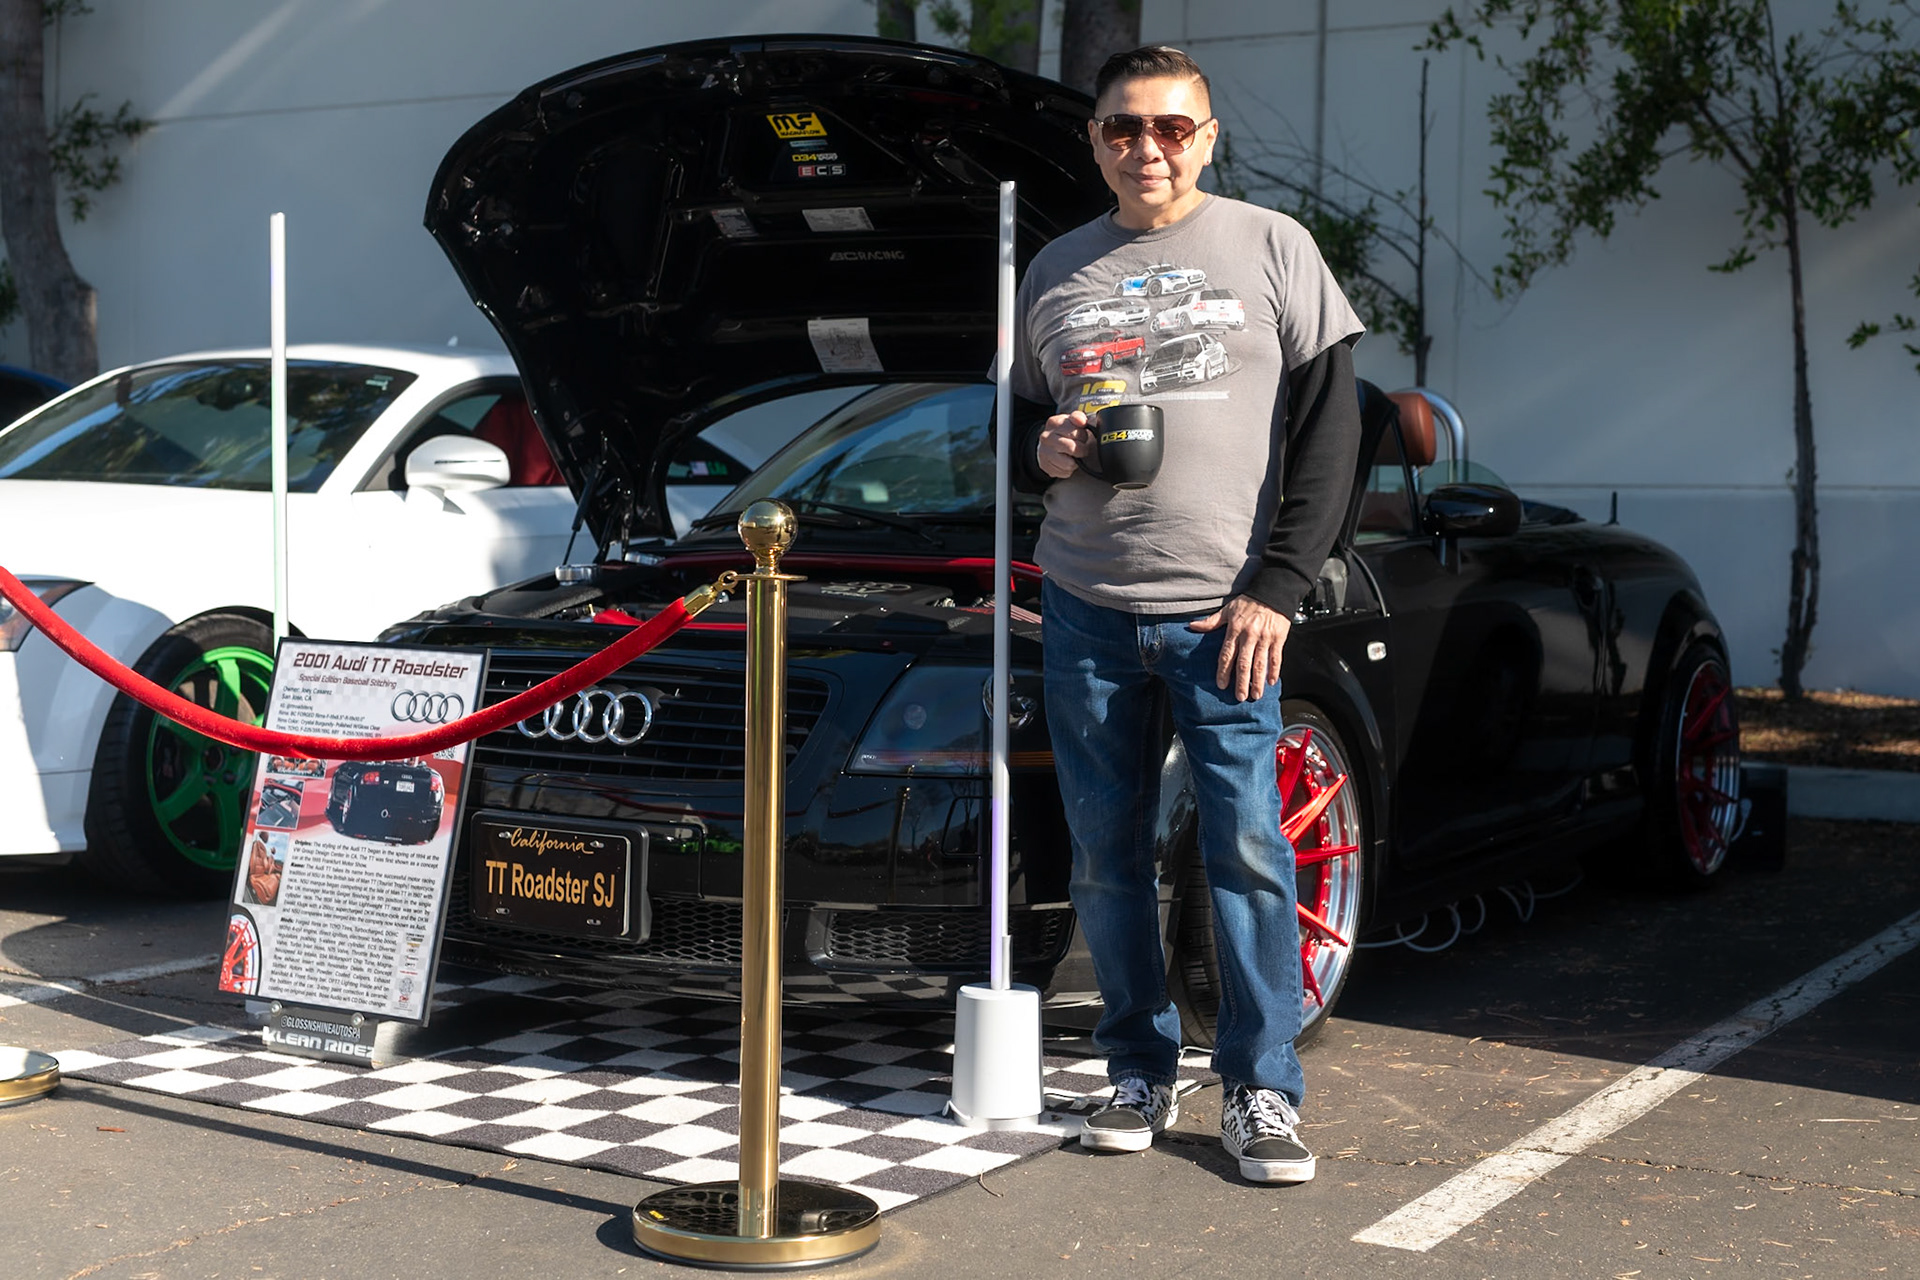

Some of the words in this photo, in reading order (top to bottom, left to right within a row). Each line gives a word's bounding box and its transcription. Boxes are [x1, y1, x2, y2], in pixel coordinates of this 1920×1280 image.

[801, 165, 844, 176] ECS
[1101, 430, 1127, 444] 034
[293, 652, 330, 669] 2001
[332, 654, 369, 672] Audi
[371, 657, 391, 674] TT
[392, 659, 469, 679] Roadster
[298, 673, 321, 684] Special
[321, 675, 342, 684] Edition
[342, 676, 370, 686] Baseball
[370, 678, 397, 689] Stitching
[510, 827, 594, 856] California
[485, 860, 508, 895] TT
[511, 862, 590, 905] Roadster
[592, 872, 616, 908] SJ
[262, 1025, 322, 1049] KLEAN
